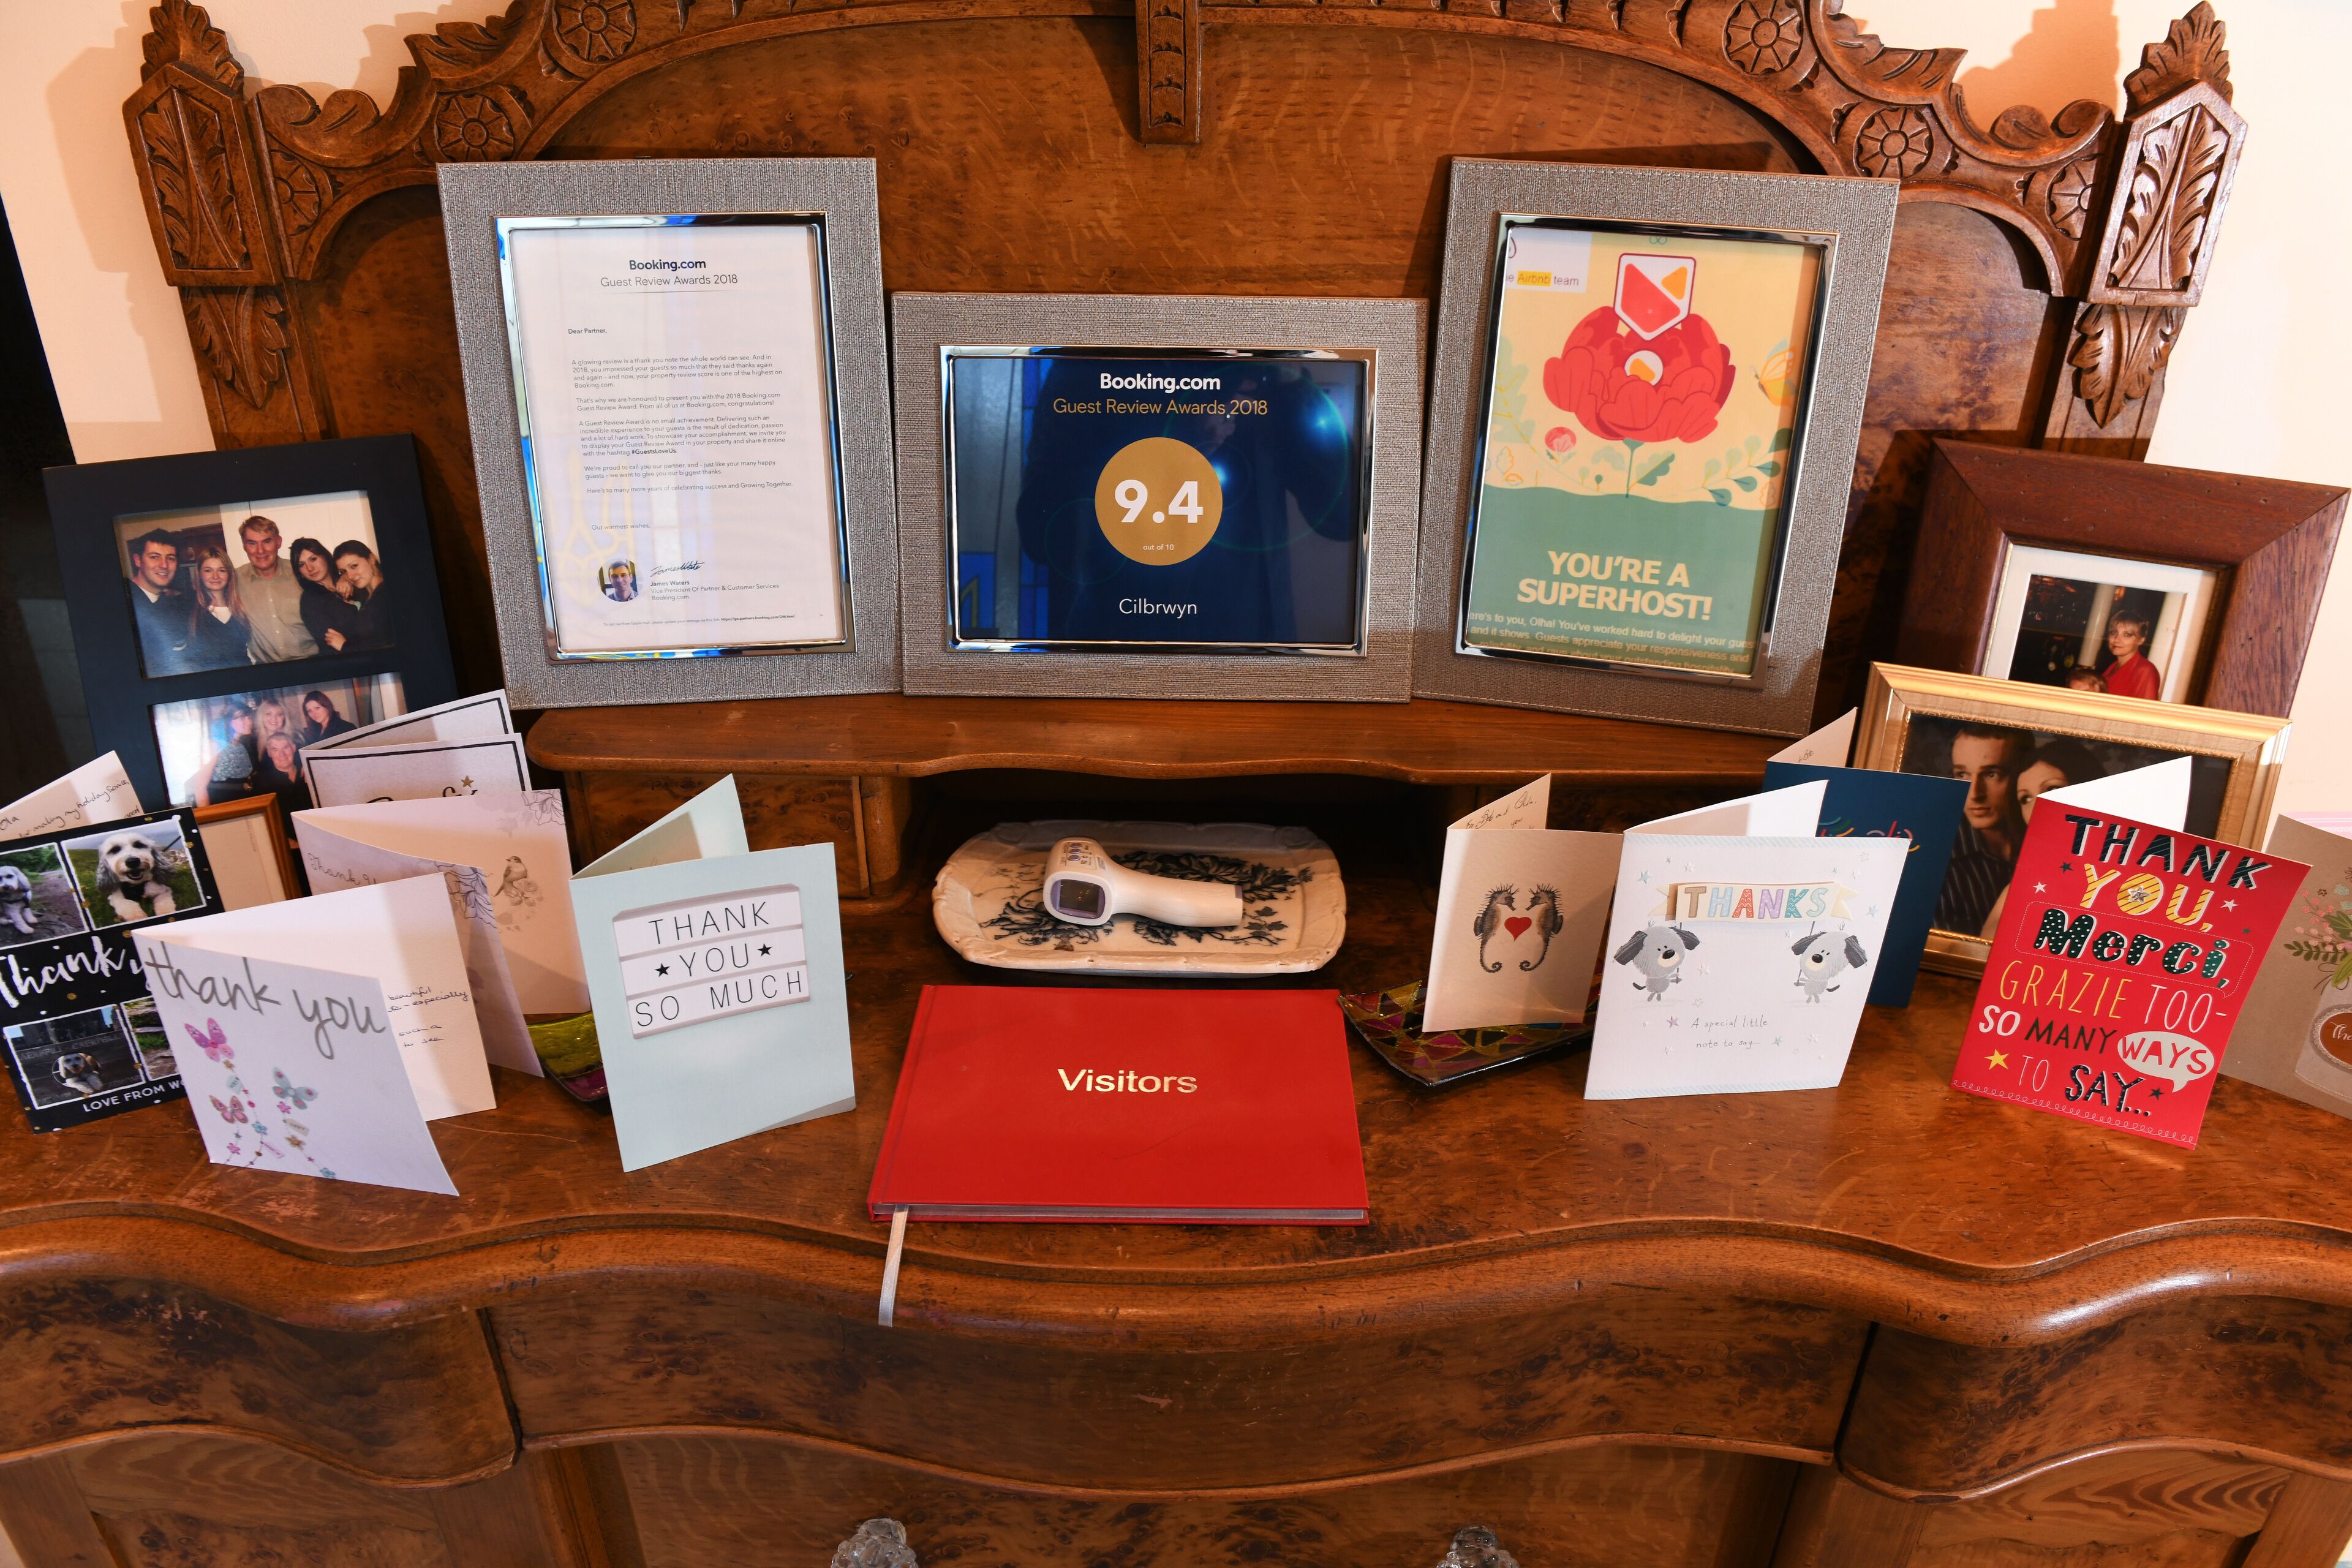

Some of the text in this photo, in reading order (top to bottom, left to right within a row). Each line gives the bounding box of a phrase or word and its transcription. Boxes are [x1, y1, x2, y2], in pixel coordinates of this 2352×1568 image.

[601, 273, 738, 287] Guest Review Awards 2018
[630, 258, 706, 273] Booking.com
[1518, 273, 1550, 284] Airbnb
[1554, 276, 1579, 285] team
[742, 391, 780, 400] Booking.com
[1100, 373, 1220, 393] Booking.com
[687, 401, 727, 409] Booking.com,
[728, 399, 774, 408] congratulations!
[1053, 398, 1268, 415] Guest Review Awards 2018
[1114, 479, 1203, 523] 9.4
[1547, 551, 1690, 588] YOU'RE A
[652, 594, 690, 602] Booking.com
[1119, 598, 1197, 618] Cilbrwyn
[1517, 578, 1713, 620] SUPERHOST!
[1469, 612, 1492, 622] ere's
[1494, 614, 1504, 623] to
[1506, 616, 1526, 627] you,
[1558, 620, 1591, 632] You've
[1593, 624, 1629, 636] worked
[1631, 627, 1653, 638] hard
[1656, 631, 1666, 639] to
[1668, 631, 1702, 644] delight
[1704, 637, 1726, 646] your
[1471, 626, 1489, 635] and
[1491, 627, 1498, 636] it
[1535, 631, 1569, 643] Guests
[1572, 637, 1623, 649] appreciate
[1626, 642, 1646, 652] your
[1649, 644, 1727, 660] responsiveness
[1730, 654, 1750, 663] and
[2065, 814, 2272, 891] THANK
[1684, 886, 1828, 919] THANKS
[2079, 863, 2214, 932] YOU,
[649, 901, 769, 944] THANK
[679, 943, 750, 977] YOU
[2034, 908, 2230, 989] Merci,
[145, 941, 281, 1015] thank
[293, 989, 386, 1060] you
[635, 970, 802, 1027] SO MUCH
[2000, 960, 2132, 1019] GRAZIE
[1691, 1014, 1768, 1030] A special little
[1696, 1039, 1719, 1049] note
[1724, 1038, 1733, 1047] to
[1978, 1005, 2207, 1075] SO MANY WAYS
[1057, 1068, 1198, 1093] Visitors
[2018, 1055, 2049, 1093] TO
[83, 1096, 119, 1112] LOVE
[124, 1084, 165, 1101] FROM
